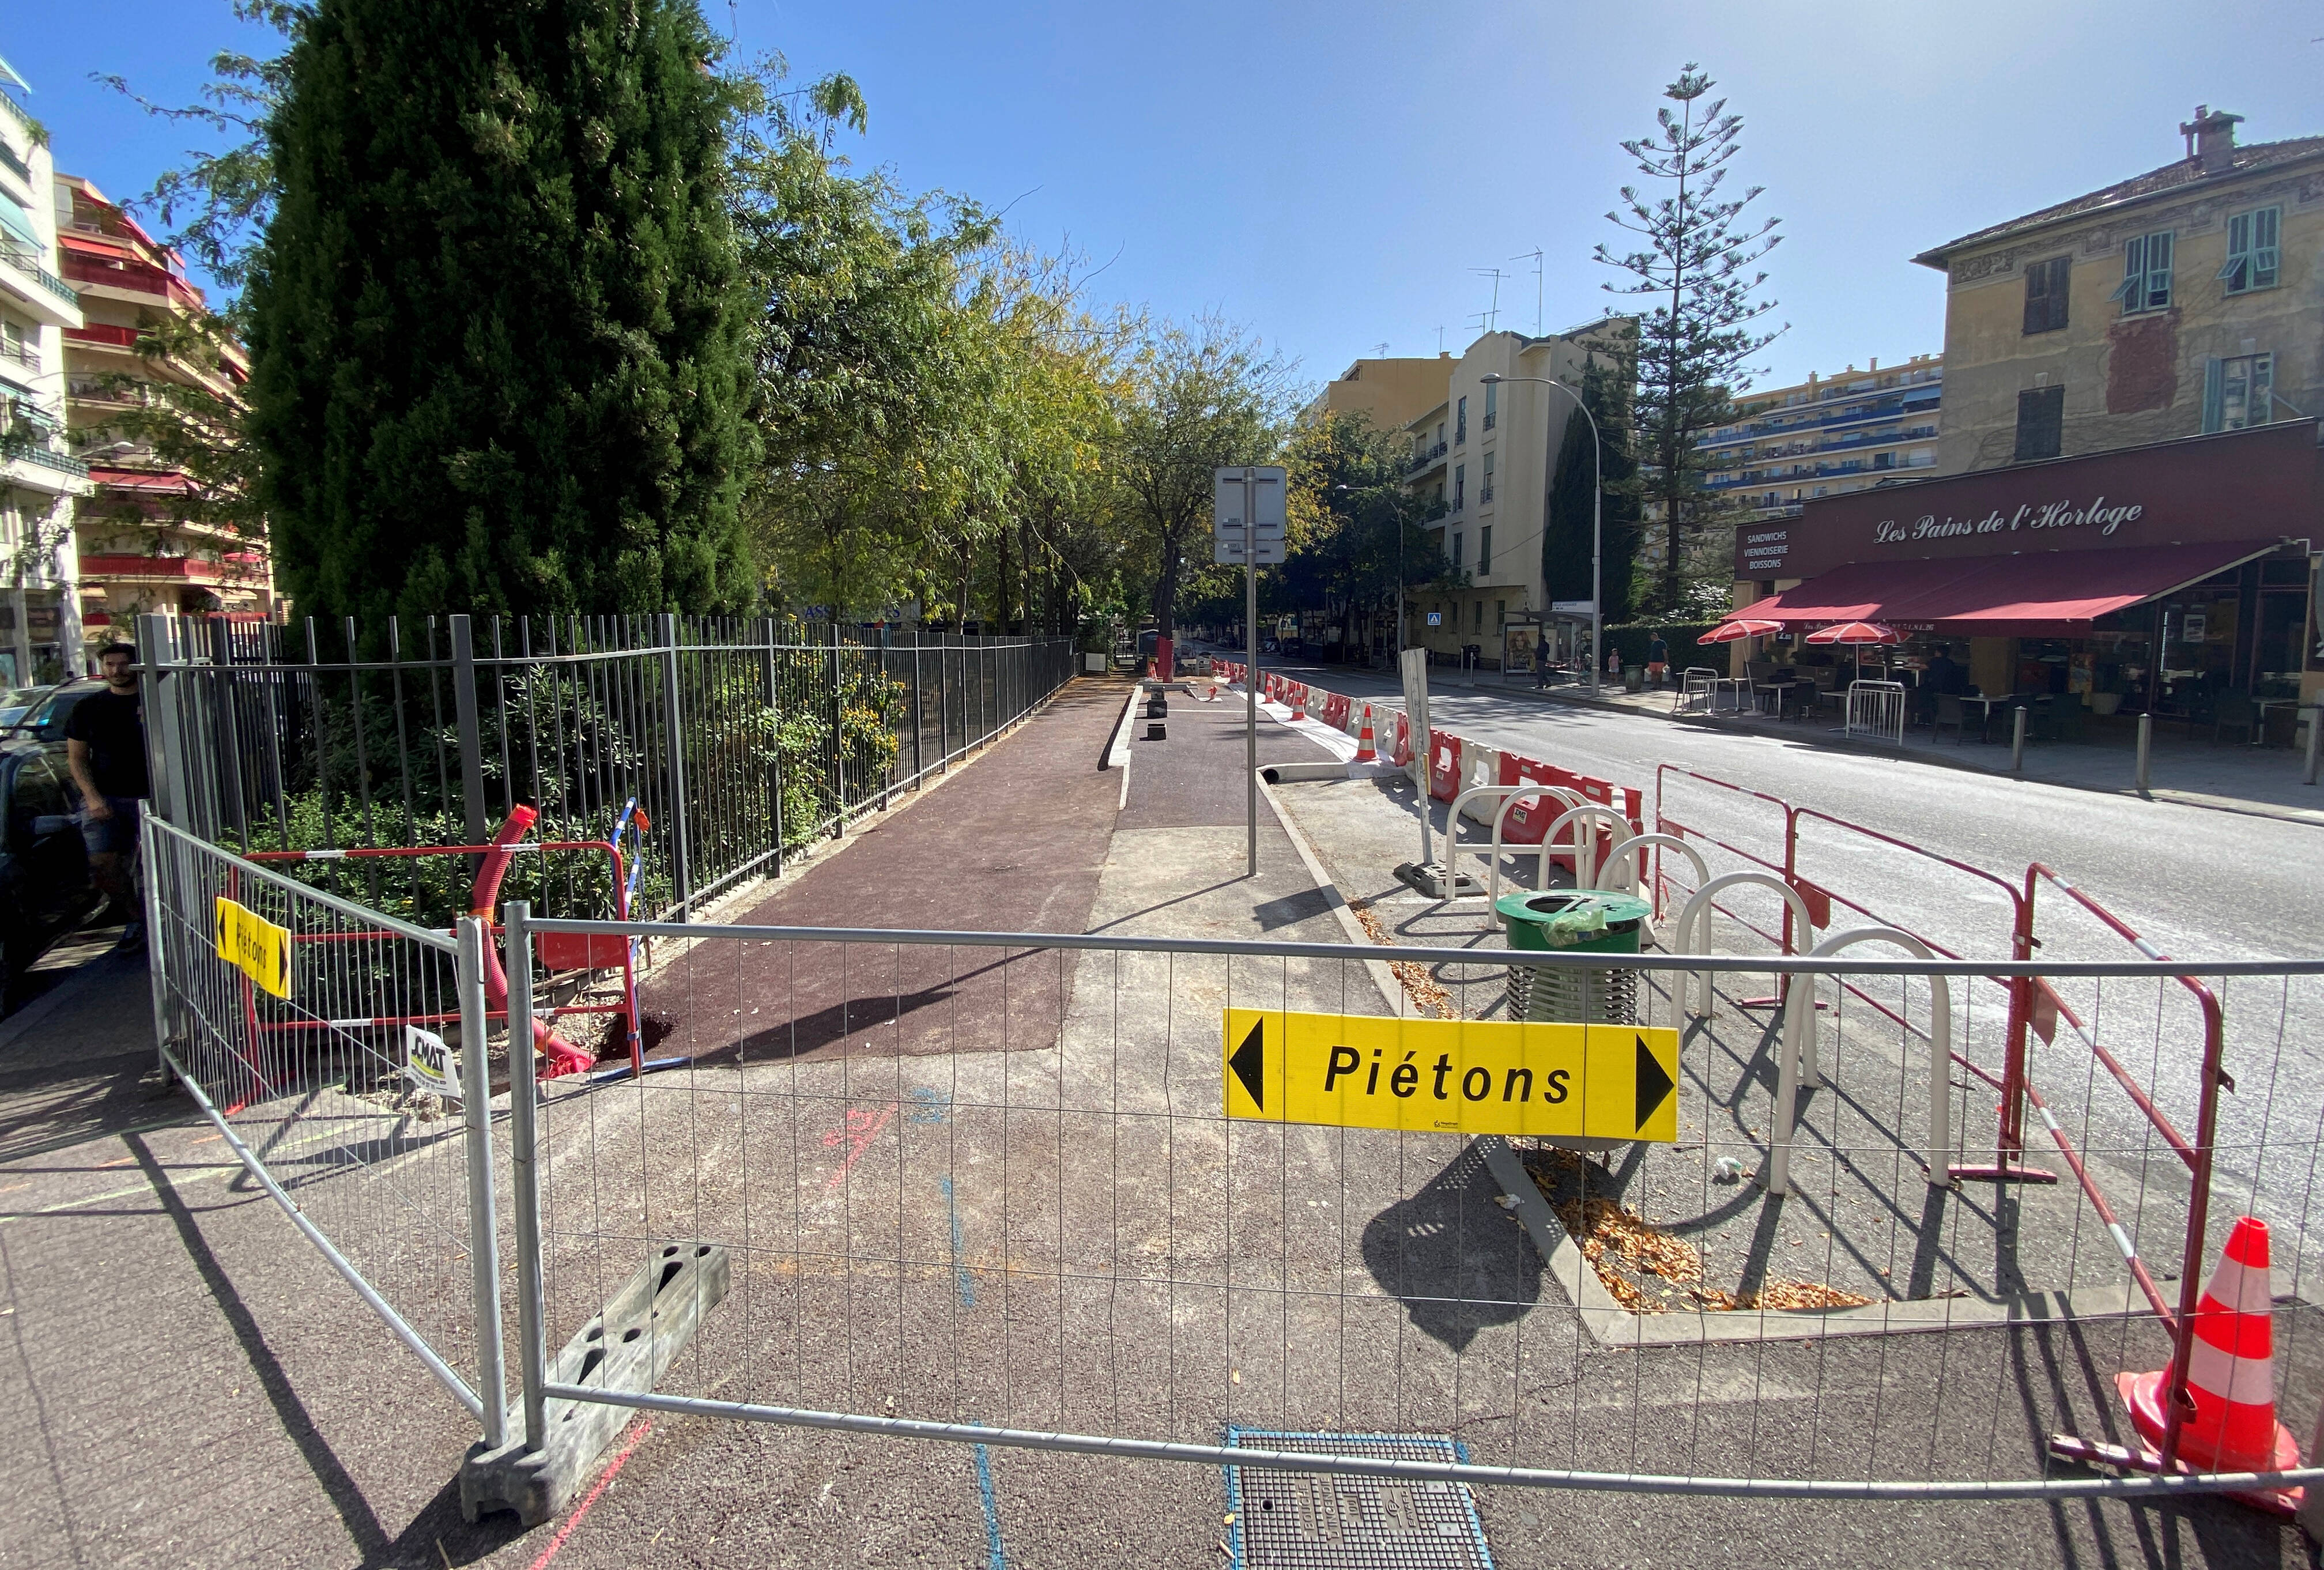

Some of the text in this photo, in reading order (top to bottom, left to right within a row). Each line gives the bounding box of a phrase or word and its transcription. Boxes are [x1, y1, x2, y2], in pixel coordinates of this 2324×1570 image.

[1748, 531, 1787, 544] SANDWICHS
[1873, 520, 1907, 544] Les
[1912, 514, 1972, 539] Pains
[1977, 511, 2004, 533] de
[1744, 545, 1789, 557] VIENNOISERIE
[1749, 559, 1782, 569] BOISSONS
[237, 922, 267, 969] Piétons
[1325, 1045, 1571, 1105] Piétons
[1298, 1484, 1315, 1531] BOUCHE
